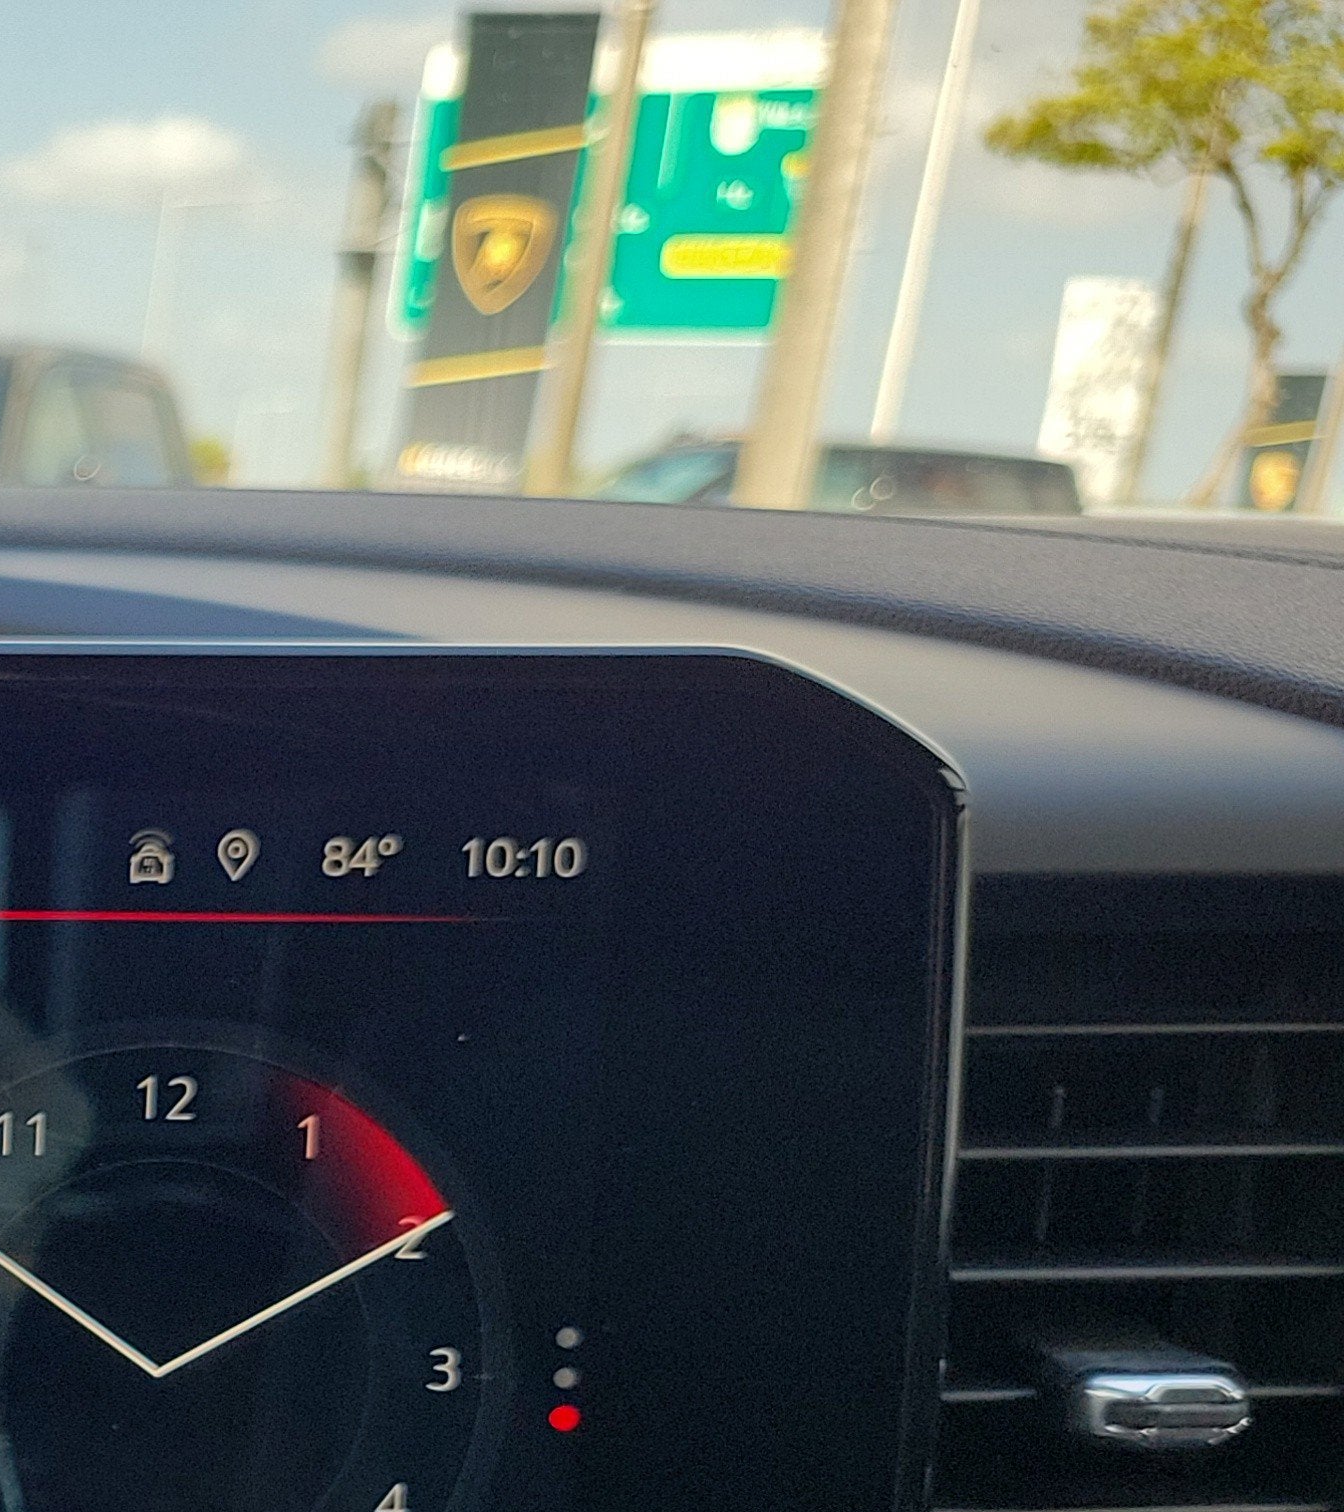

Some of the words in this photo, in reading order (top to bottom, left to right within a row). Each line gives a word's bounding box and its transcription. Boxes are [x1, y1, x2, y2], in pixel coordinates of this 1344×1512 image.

[462, 836, 587, 878] 10:10
[135, 1074, 199, 1123] 12
[297, 1114, 321, 1161] 1
[395, 1214, 428, 1260] 2
[424, 1347, 463, 1392] 3
